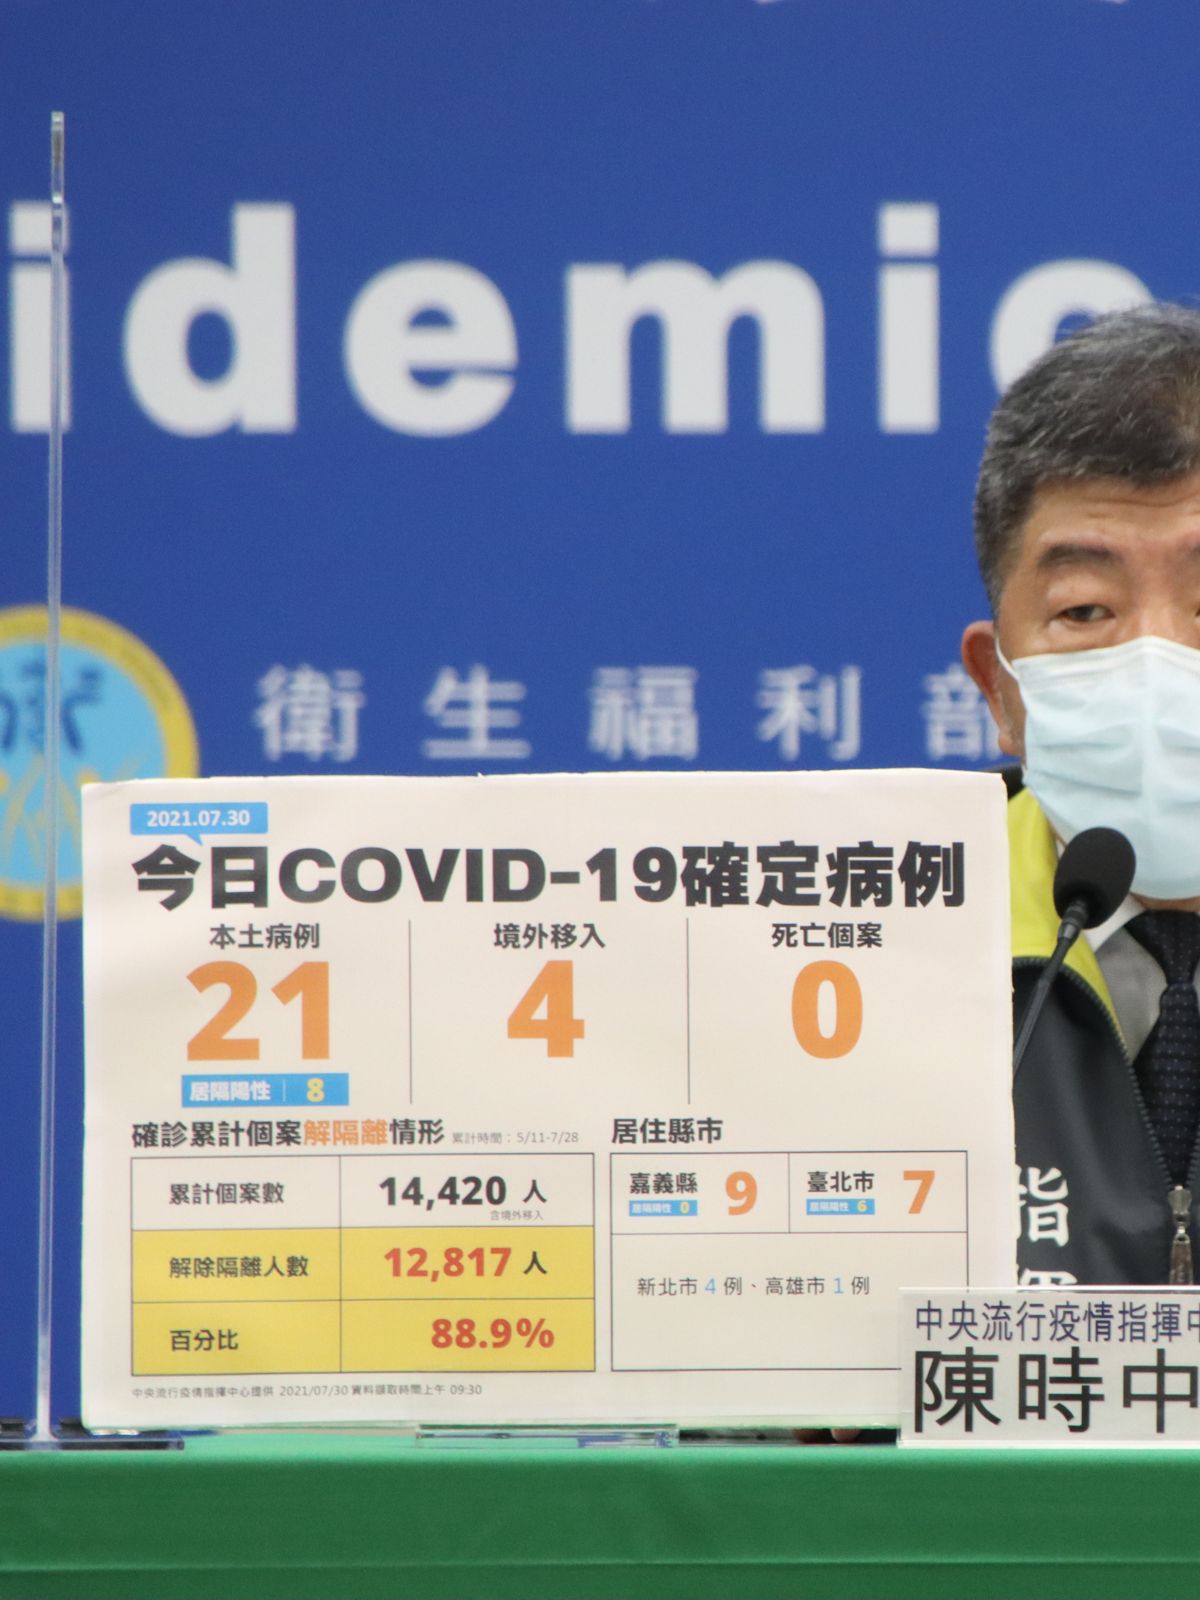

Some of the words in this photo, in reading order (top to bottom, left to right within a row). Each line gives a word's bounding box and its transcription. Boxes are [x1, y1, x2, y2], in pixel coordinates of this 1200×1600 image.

[147, 810, 250, 827] 2021.07.30
[132, 841, 965, 911] 今日COVID-19確定病例
[210, 923, 320, 950] 本土病例
[494, 923, 606, 950] 境外移入
[772, 922, 883, 949] 死亡個案
[187, 961, 330, 1061] 21
[507, 960, 585, 1058] 4
[792, 960, 863, 1060] 0
[307, 1077, 325, 1102] 8
[132, 1118, 445, 1149] 確診累計個案解隔離情形
[611, 1117, 723, 1144] 居住縣市
[169, 1182, 284, 1204] 累計個案數
[379, 1175, 507, 1211] 14,420
[523, 1179, 547, 1203] 人
[629, 1172, 698, 1194] 嘉義縣
[725, 1170, 758, 1216] 9
[679, 1202, 690, 1214] 0
[807, 1171, 875, 1193] 臺北市
[903, 1170, 935, 1215] 7
[857, 1200, 867, 1212] 6
[169, 1256, 309, 1279] 解除隔離人數
[384, 1247, 511, 1282] 12,817
[523, 1251, 547, 1275] 人
[637, 1277, 698, 1296] 新北市
[170, 1329, 238, 1351] 百分比
[431, 1318, 554, 1349] 88.9%
[280, 1385, 348, 1398] 2021/07/30
[450, 1384, 482, 1396] 09:30
[914, 1346, 1199, 1433] 陳時中
